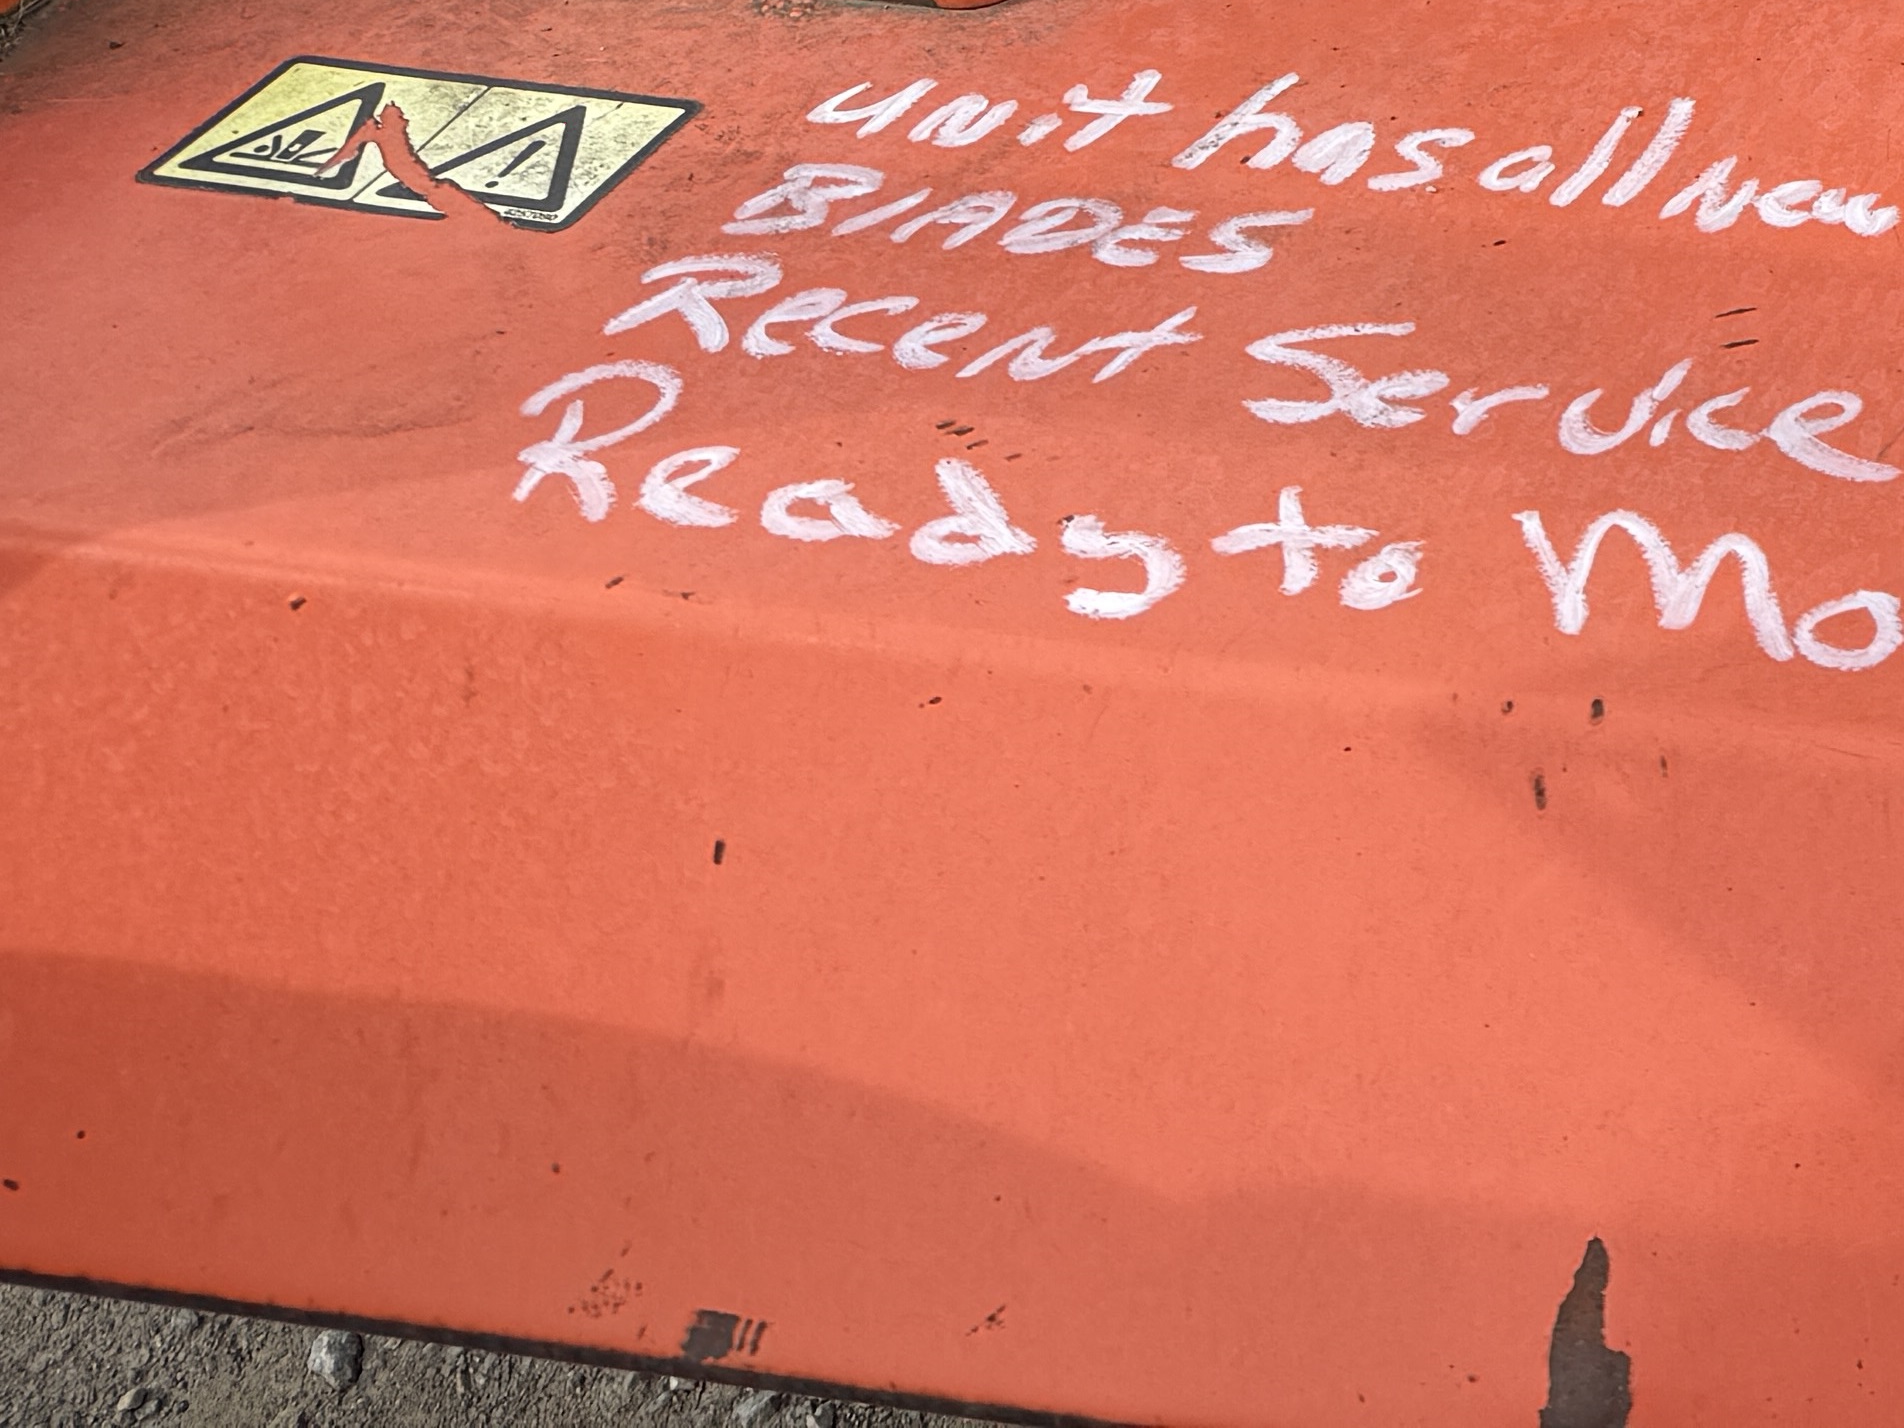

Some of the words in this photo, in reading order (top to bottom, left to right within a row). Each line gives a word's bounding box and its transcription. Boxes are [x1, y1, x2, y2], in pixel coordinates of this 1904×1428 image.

[1173, 73, 1475, 191] has
[1479, 98, 1695, 206] all
[604, 254, 1202, 382] Recent
[1244, 322, 1901, 483] Service
[514, 361, 1185, 620] Ready
[1211, 487, 1423, 610] to
